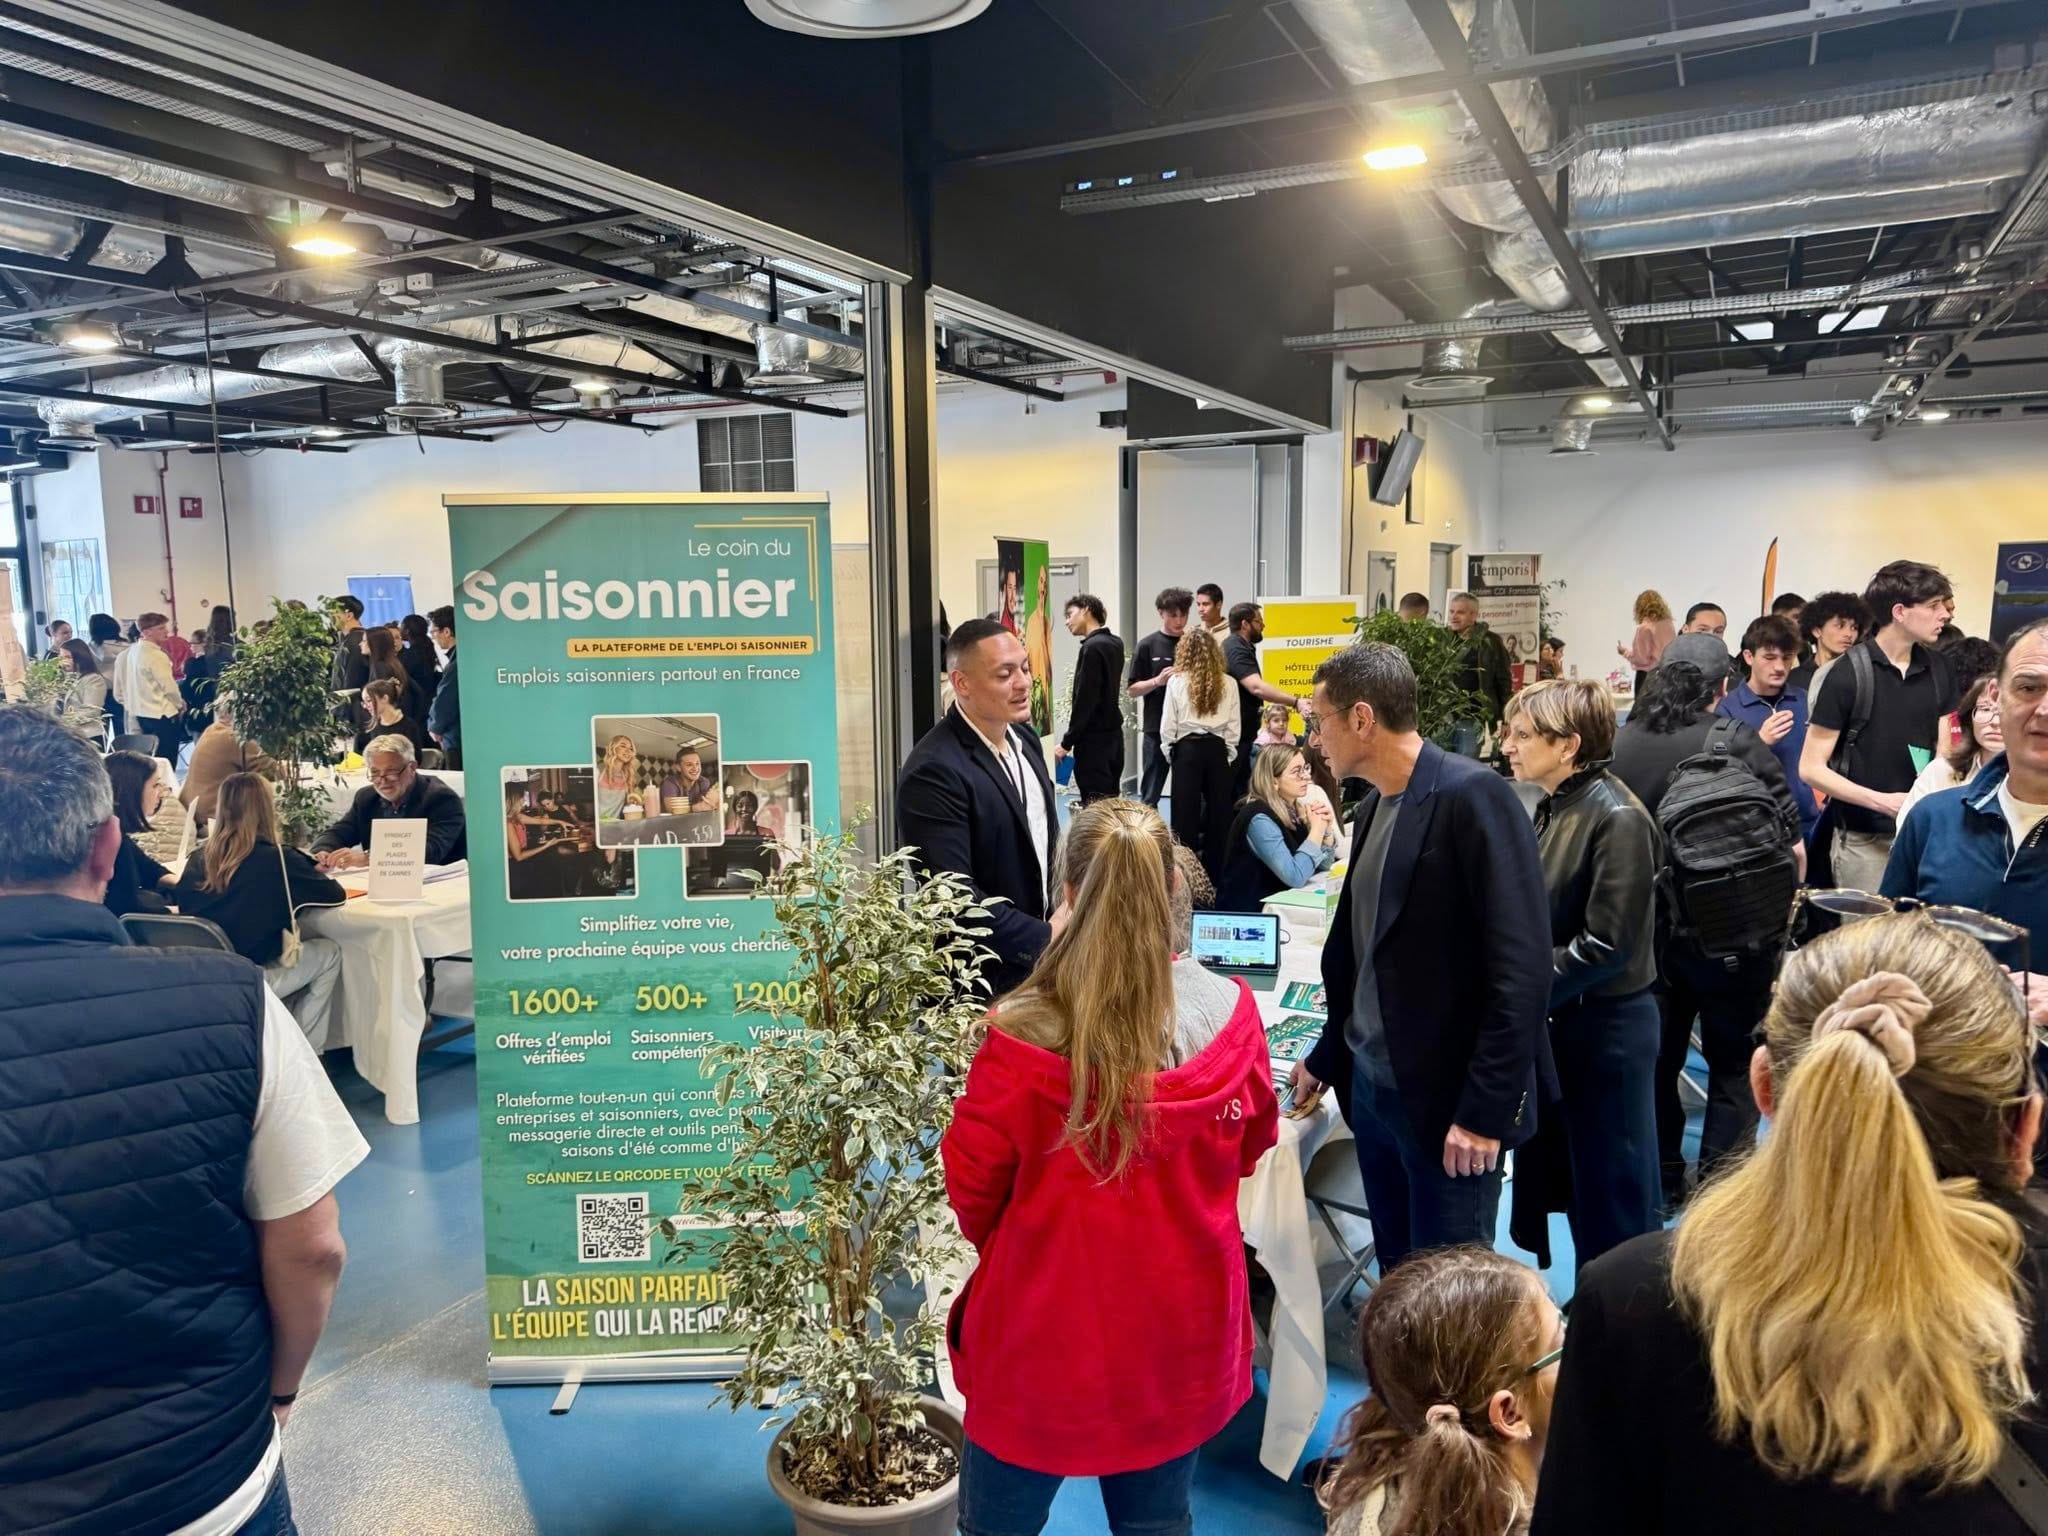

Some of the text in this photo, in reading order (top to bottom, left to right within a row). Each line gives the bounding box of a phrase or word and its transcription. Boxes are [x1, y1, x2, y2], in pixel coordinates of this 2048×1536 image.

[687, 537, 791, 557] Le coin du
[1470, 561, 1530, 581] Temporis
[462, 568, 796, 622] Saisonnier
[574, 639, 808, 653] LA PLATEFORME DE L'EMPLOI SAISONNIER
[1286, 637, 1335, 647] TOURISME
[497, 664, 801, 688] Emplois saisonniers partout en France
[1285, 663, 1320, 672] HÔTELLE
[1279, 679, 1314, 687] RESTAUR
[580, 913, 735, 934] Simplifiez votre vie,
[501, 936, 791, 961] votre prochaine équipe vous cherche
[508, 988, 599, 1015] 1600+
[635, 984, 708, 1011] 500+
[733, 981, 808, 1006] 1200
[496, 1030, 612, 1049] Offres d'emploi
[631, 1029, 714, 1044] Saisonniers
[748, 1025, 804, 1041] Visiteur
[522, 1048, 586, 1065] vérifiées
[496, 1092, 574, 1108] Plateforme
[579, 1090, 647, 1104] tout-en-un
[652, 1089, 675, 1105] qui
[496, 1111, 576, 1126] entreprises
[580, 1109, 594, 1121] et
[598, 1107, 683, 1122] saisonniers,
[689, 1106, 724, 1118] avec
[508, 1122, 745, 1143] messagerie directe et outils pens
[561, 1144, 614, 1158] saisons
[619, 1140, 655, 1156] d'été
[659, 1143, 713, 1155] comme
[526, 1171, 593, 1185] SCANNEZ
[596, 1170, 612, 1182] LE
[613, 1168, 671, 1182] QRCODE
[674, 1167, 691, 1180] ET
[522, 1279, 551, 1307] LA
[555, 1276, 635, 1306] SAISON
[641, 1273, 731, 1304] PARFAIT
[493, 1308, 590, 1340] L'ÉQUIPE
[594, 1308, 632, 1337] QUI
[636, 1308, 664, 1336] LA
[669, 1307, 728, 1335] REND
